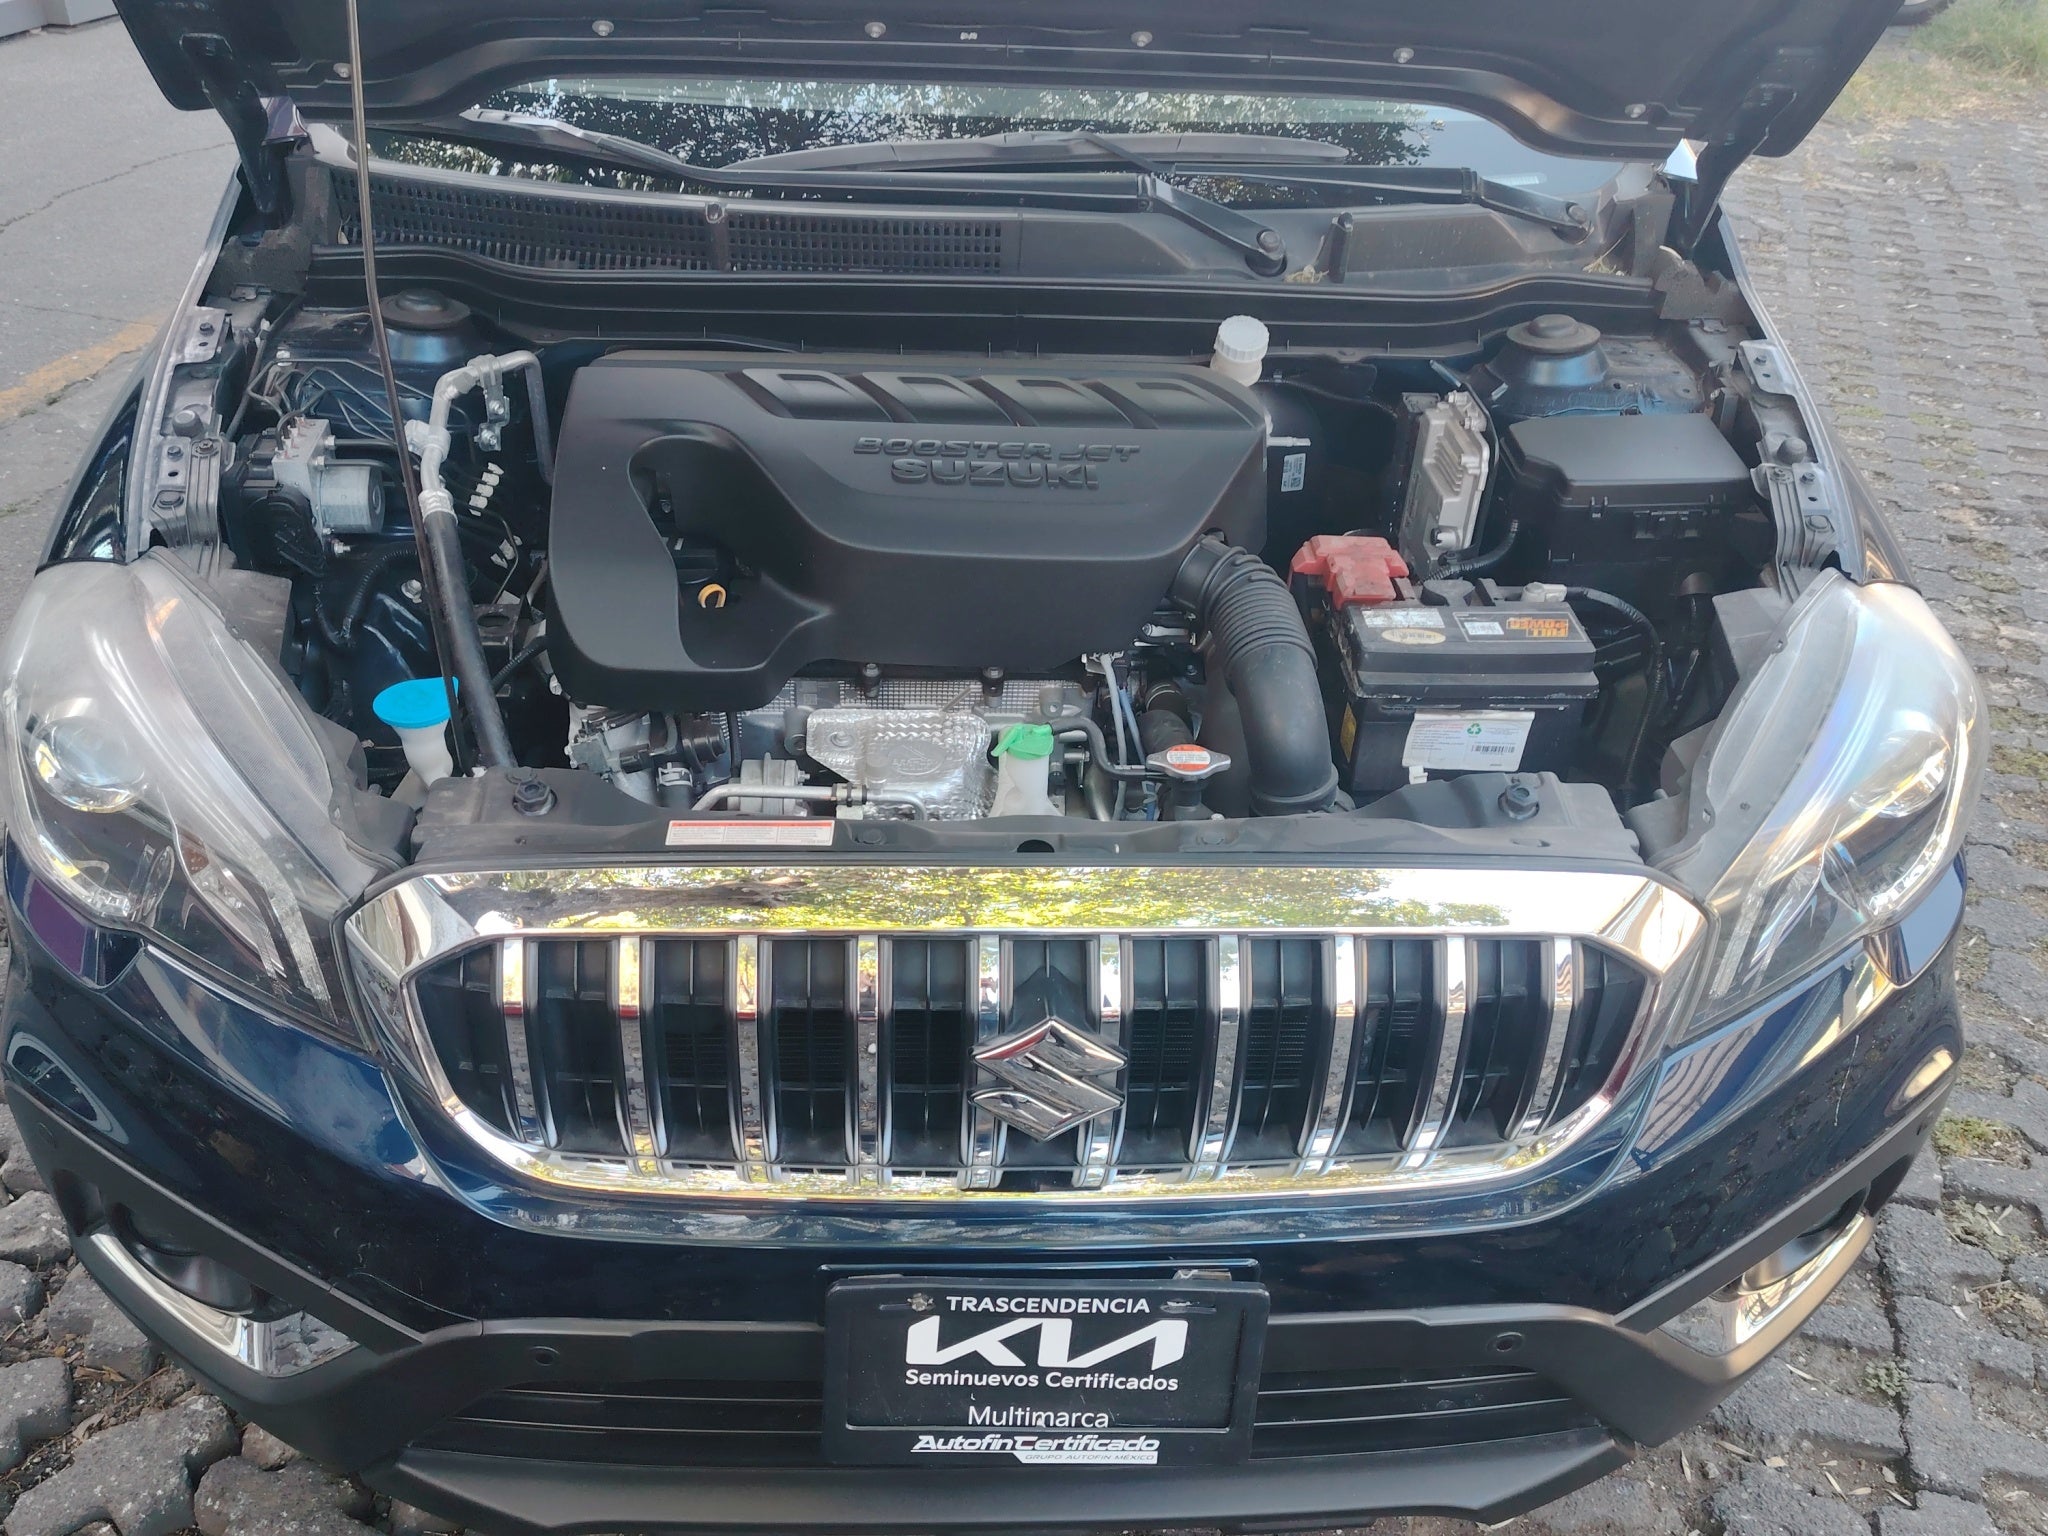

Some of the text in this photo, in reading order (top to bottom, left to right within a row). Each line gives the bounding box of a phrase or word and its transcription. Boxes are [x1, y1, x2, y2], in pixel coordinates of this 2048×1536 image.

[853, 437, 1140, 462] BOOSTER JET
[891, 458, 1099, 489] SUZUKI
[946, 1295, 1150, 1313] TRASCENDENCIA
[905, 1315, 1188, 1370] KIA
[905, 1369, 1179, 1391] Seminuevos Certificados
[967, 1405, 1109, 1428] Multimarca
